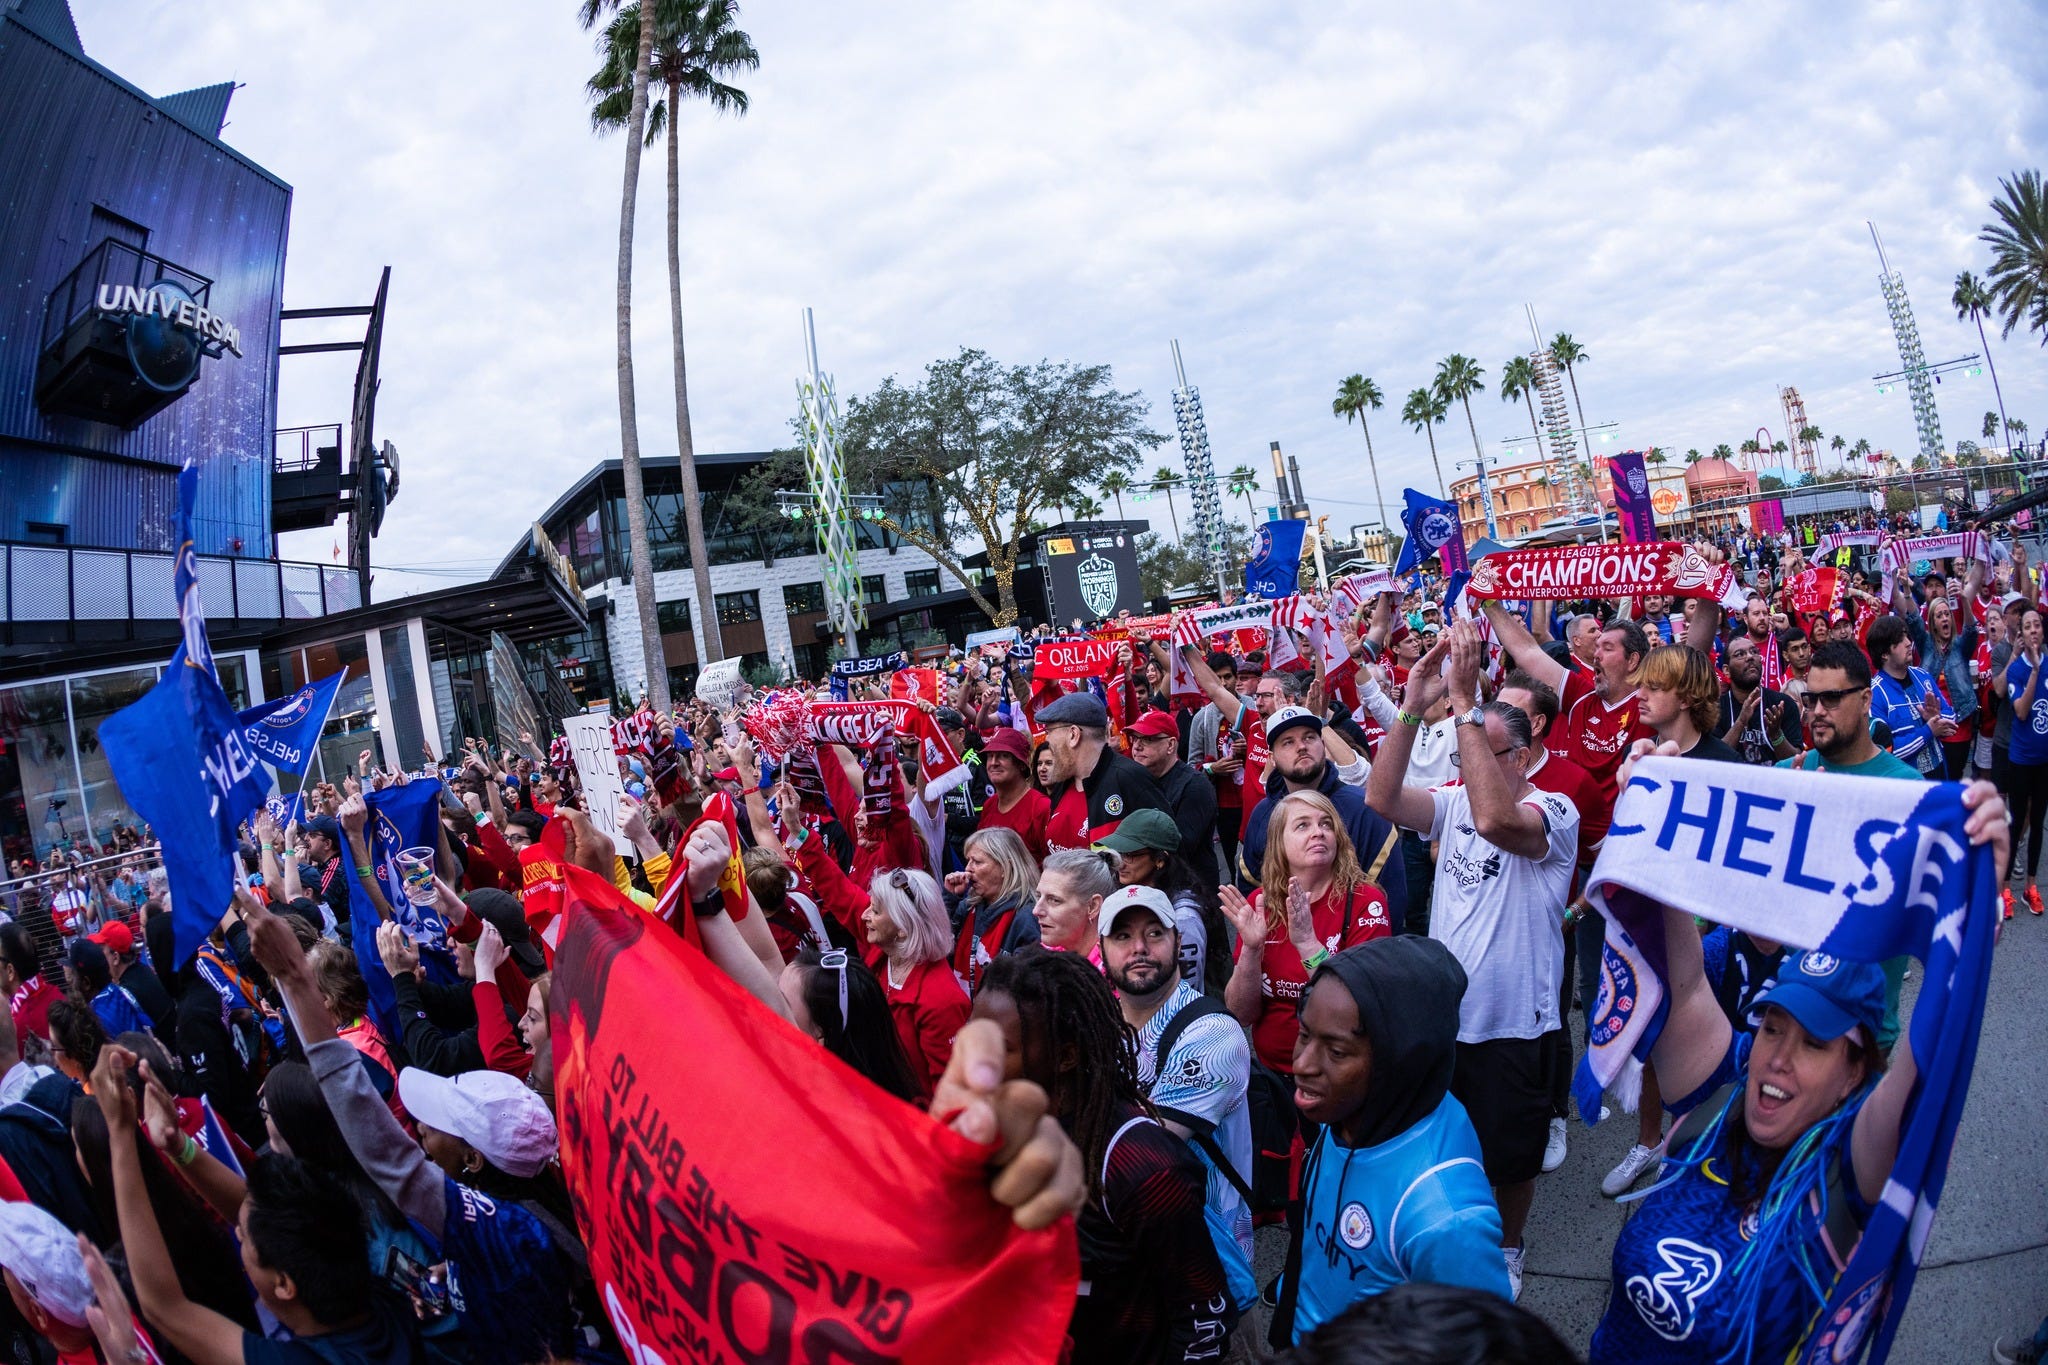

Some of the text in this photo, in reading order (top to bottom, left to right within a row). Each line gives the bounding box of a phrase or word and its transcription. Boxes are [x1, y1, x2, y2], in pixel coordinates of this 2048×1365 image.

[97, 283, 243, 358] UNIVERSAL
[1909, 532, 1961, 550] JACKSONVILLE
[1560, 547, 1601, 559] LEAGUE
[1505, 552, 1657, 588] CHAMPIONS
[1082, 575, 1114, 585] MORNINGS
[1090, 583, 1110, 594] LIVE
[1522, 584, 1634, 599] LIVERPOOL 2019/2020
[560, 667, 584, 680] BAR
[835, 657, 884, 674] HELSEA
[1608, 775, 1968, 914] CHELSE
[1160, 1073, 1214, 1091] Expedia
